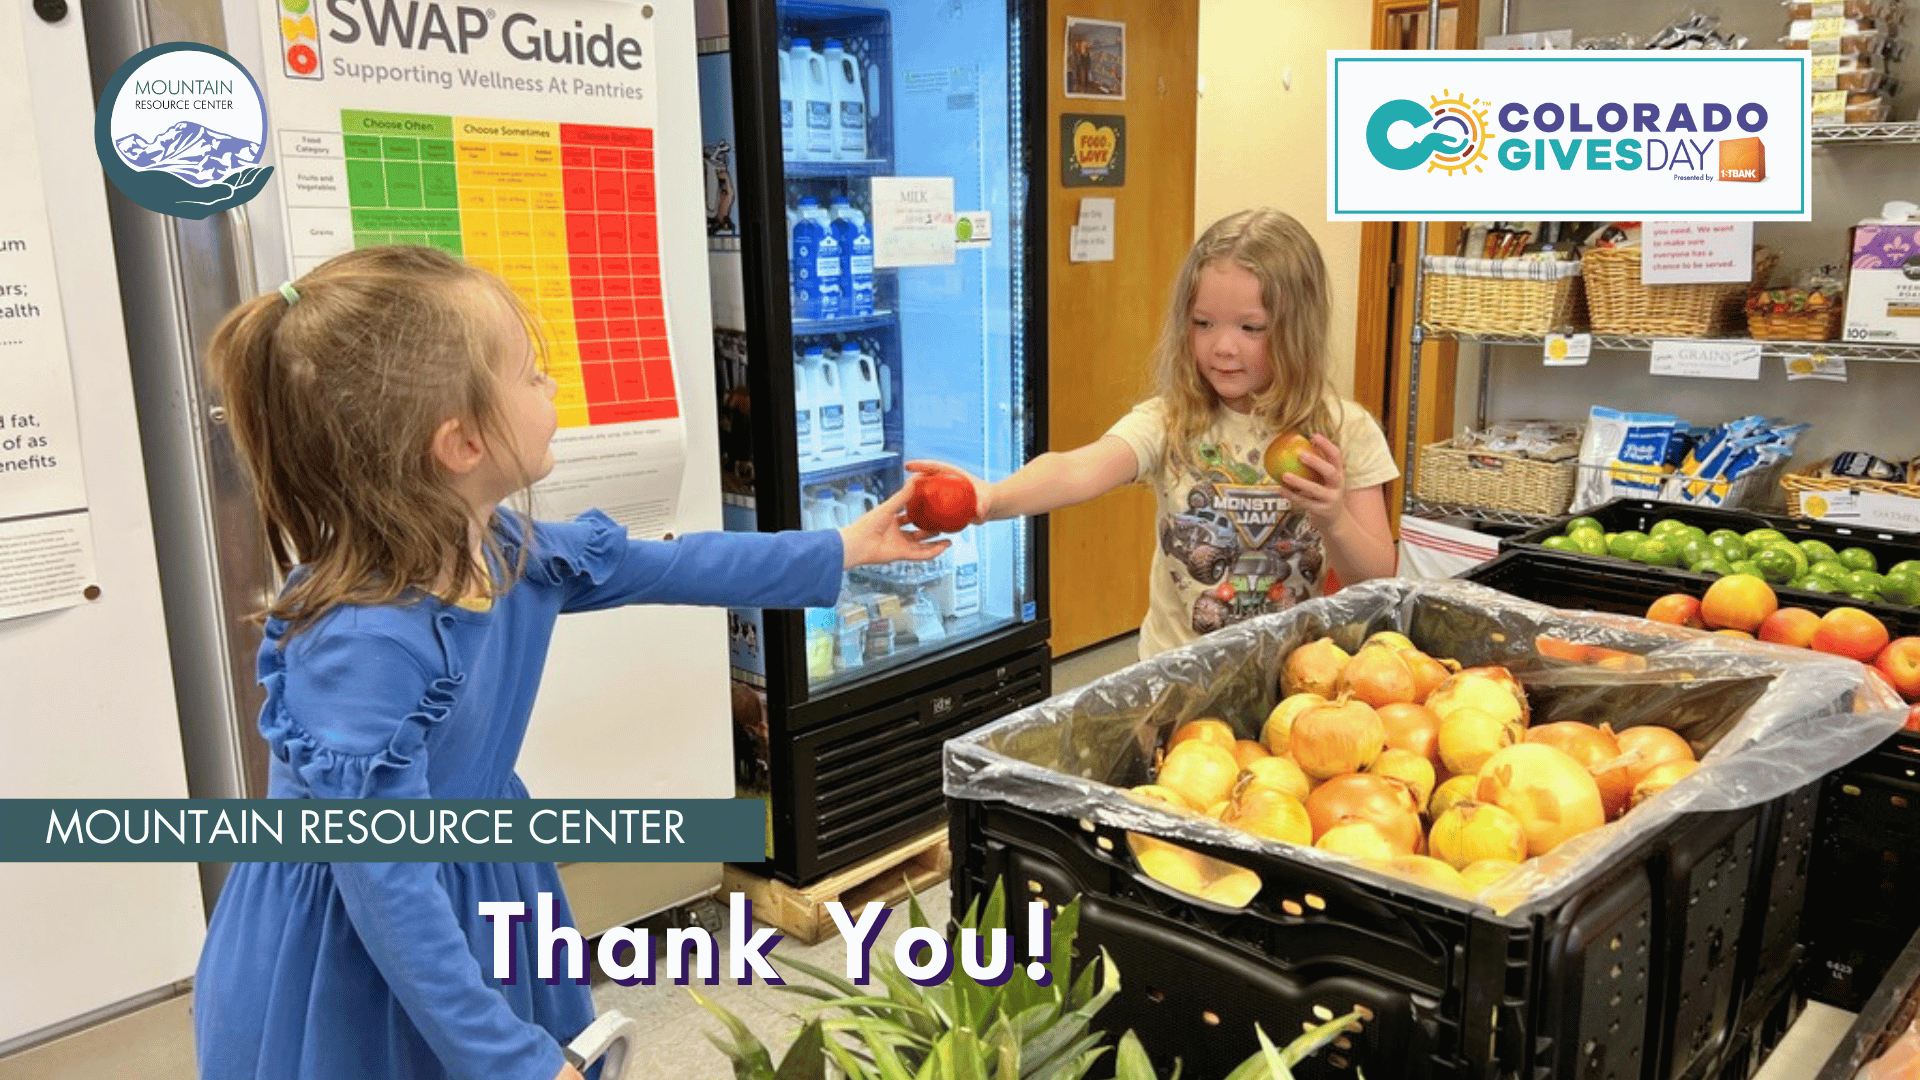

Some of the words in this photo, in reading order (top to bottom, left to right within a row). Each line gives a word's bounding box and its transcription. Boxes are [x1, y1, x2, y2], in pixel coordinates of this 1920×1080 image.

[502, 12, 643, 70] Guide
[333, 57, 453, 89] Supporting
[459, 68, 543, 92] Wellness
[549, 77, 568, 94] At
[573, 78, 643, 100] Pantries
[363, 117, 403, 131] Choose
[404, 119, 434, 132] Often
[463, 124, 499, 136] Choose
[501, 125, 550, 138] Sometimes
[901, 190, 928, 204] MILK
[1847, 327, 1869, 340] 100
[1678, 349, 1732, 362] GRAINS
[3, 435, 22, 451] of
[28, 435, 48, 448] as
[1237, 511, 1277, 524] JAM
